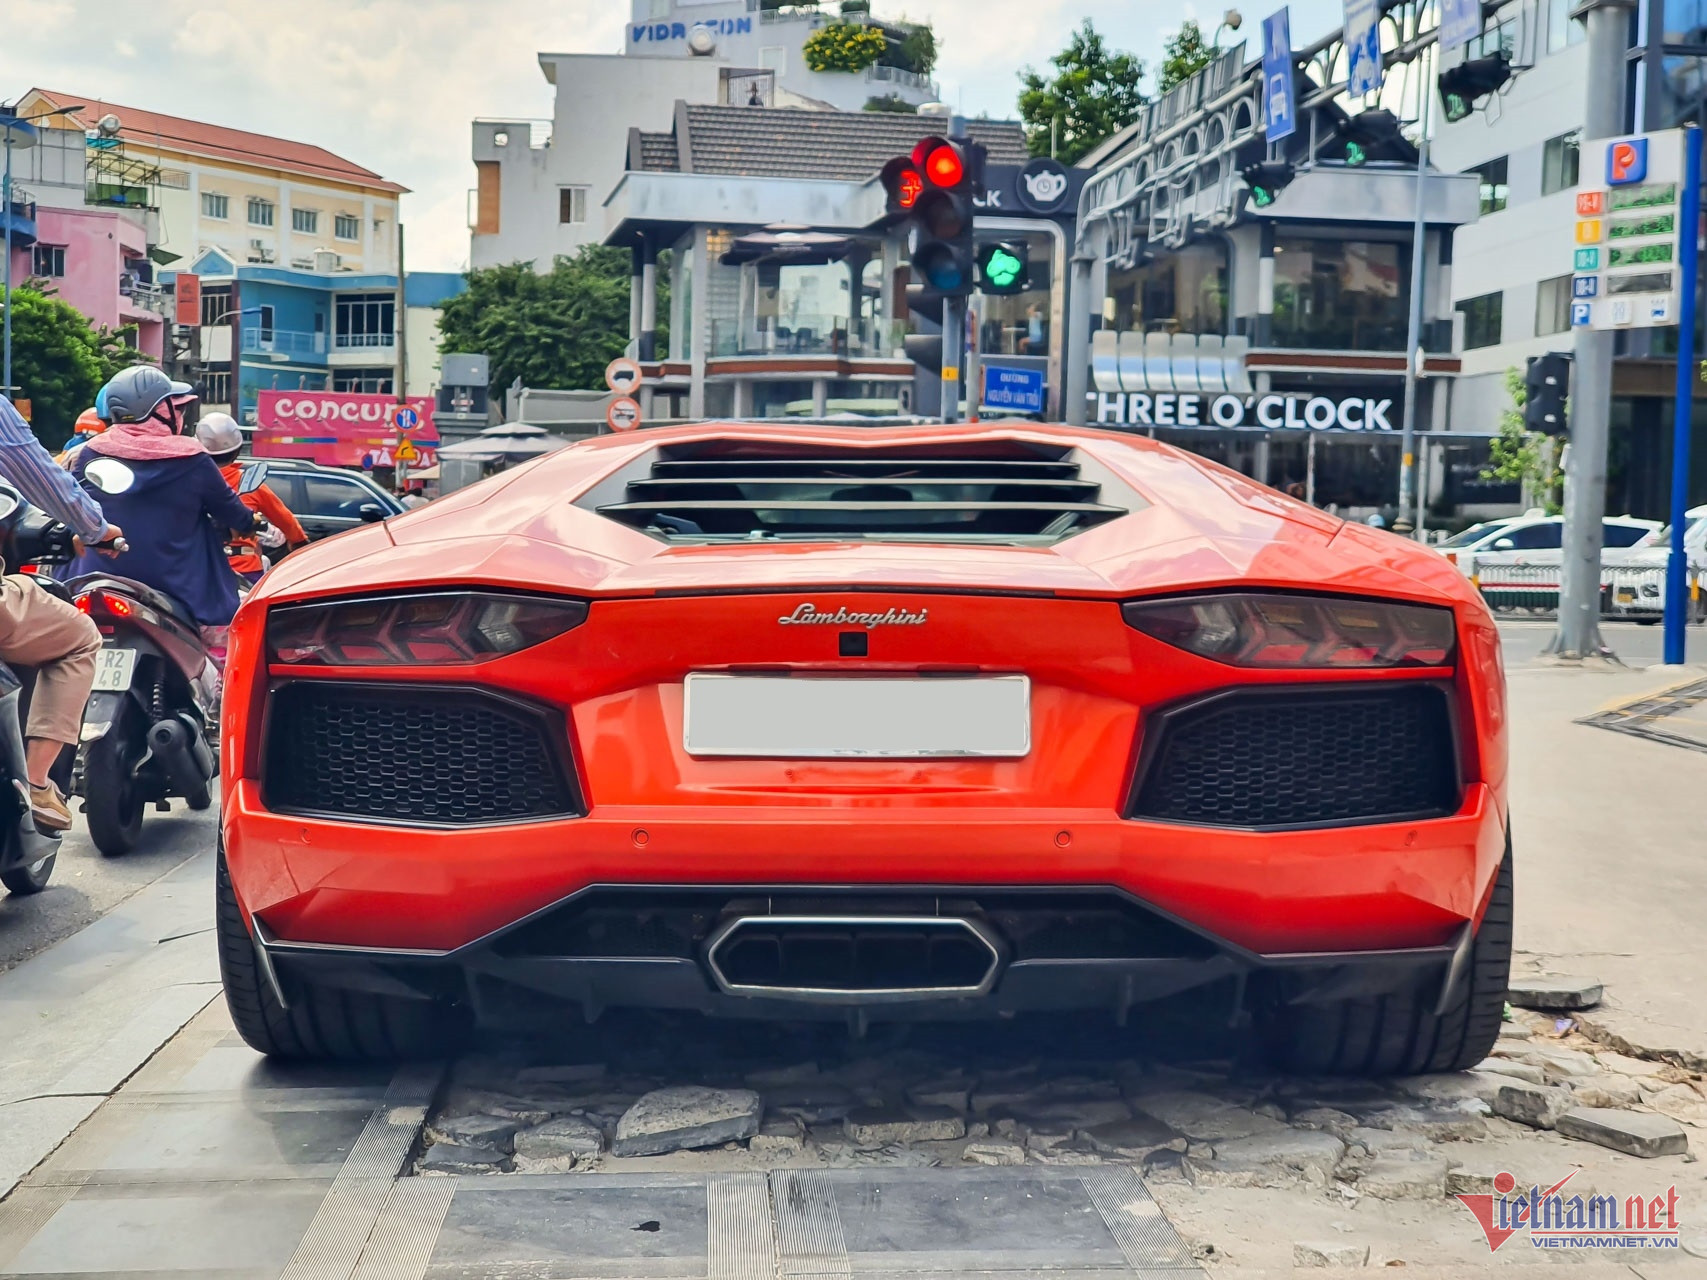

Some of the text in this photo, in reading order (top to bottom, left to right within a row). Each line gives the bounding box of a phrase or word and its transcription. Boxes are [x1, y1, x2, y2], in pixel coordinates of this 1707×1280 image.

[1086, 393, 1393, 430] HREE O'CLOCK
[778, 602, 928, 629] Lamborghini
